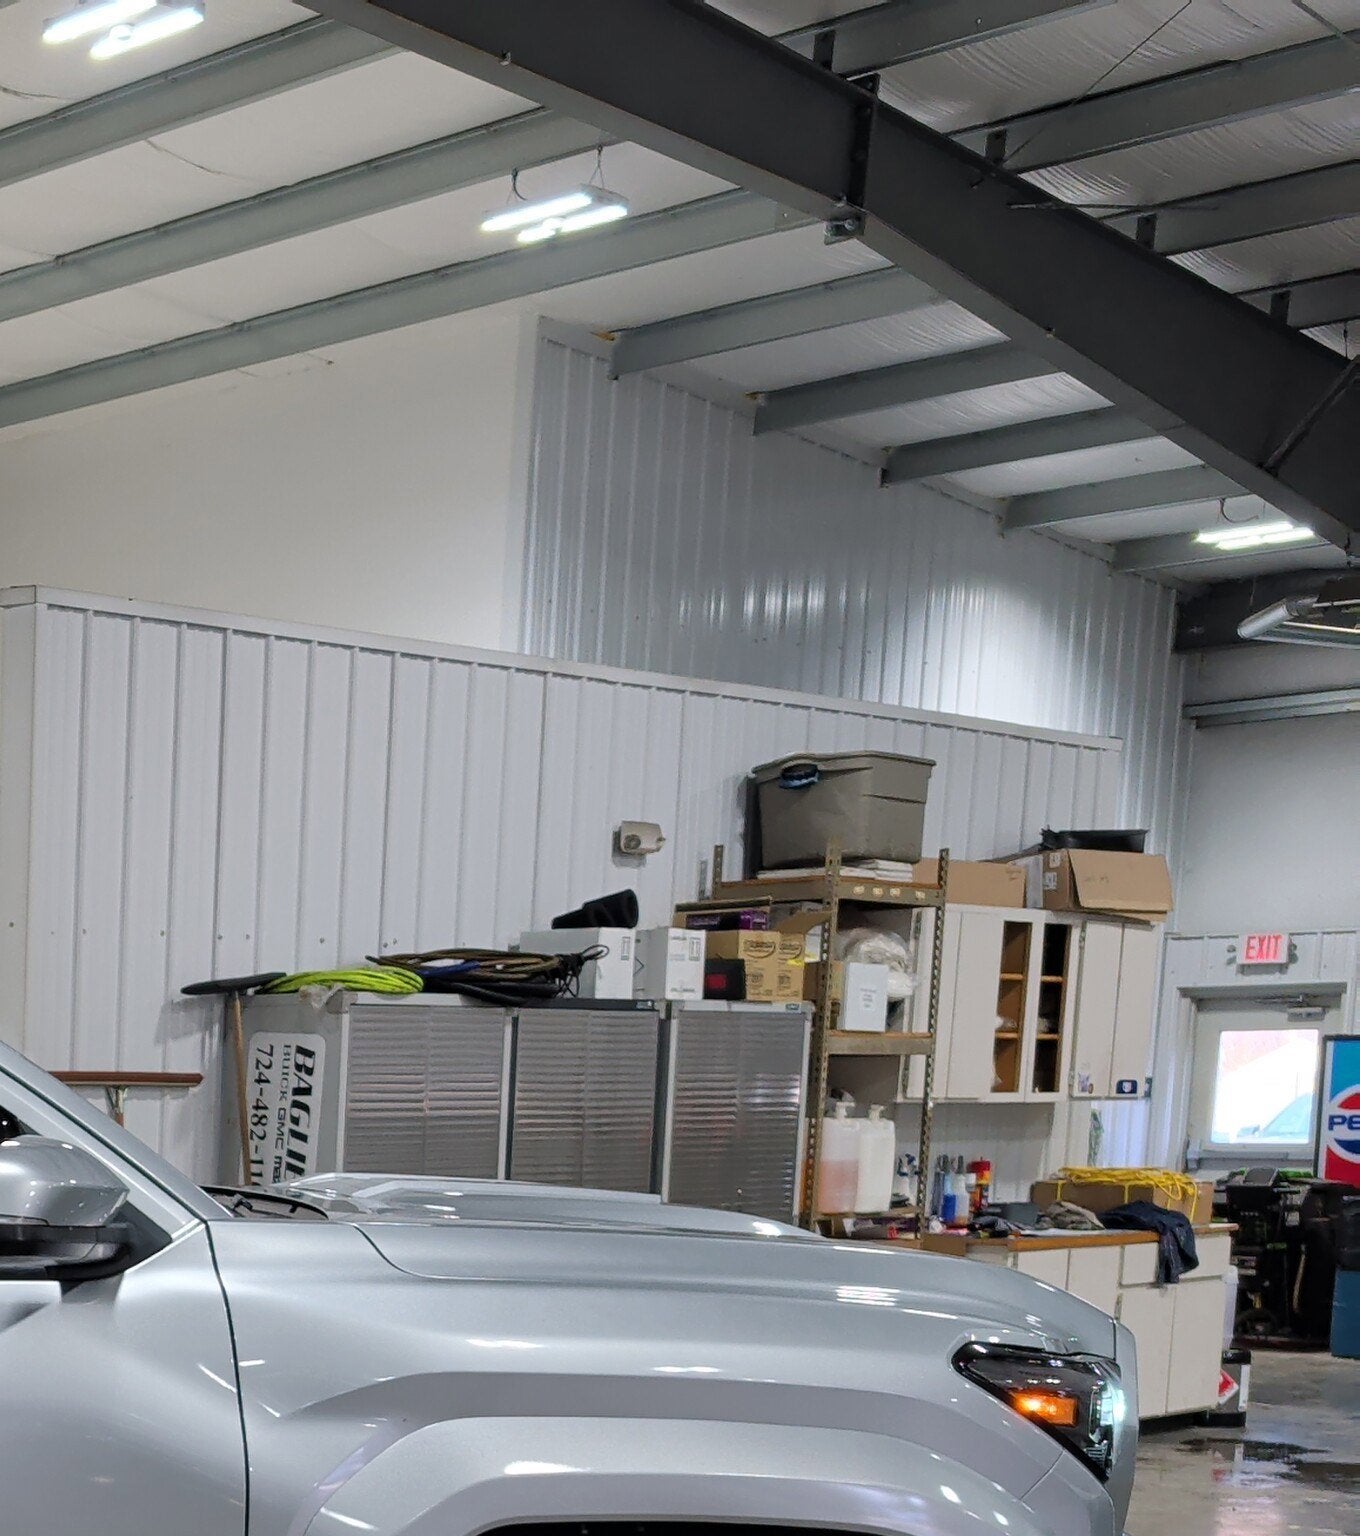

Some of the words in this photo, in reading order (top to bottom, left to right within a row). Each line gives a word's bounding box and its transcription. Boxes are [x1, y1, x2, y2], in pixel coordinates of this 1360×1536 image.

[1245, 934, 1283, 960] EXIT
[279, 1044, 292, 1102] BUICK
[274, 1107, 287, 1150] GMC
